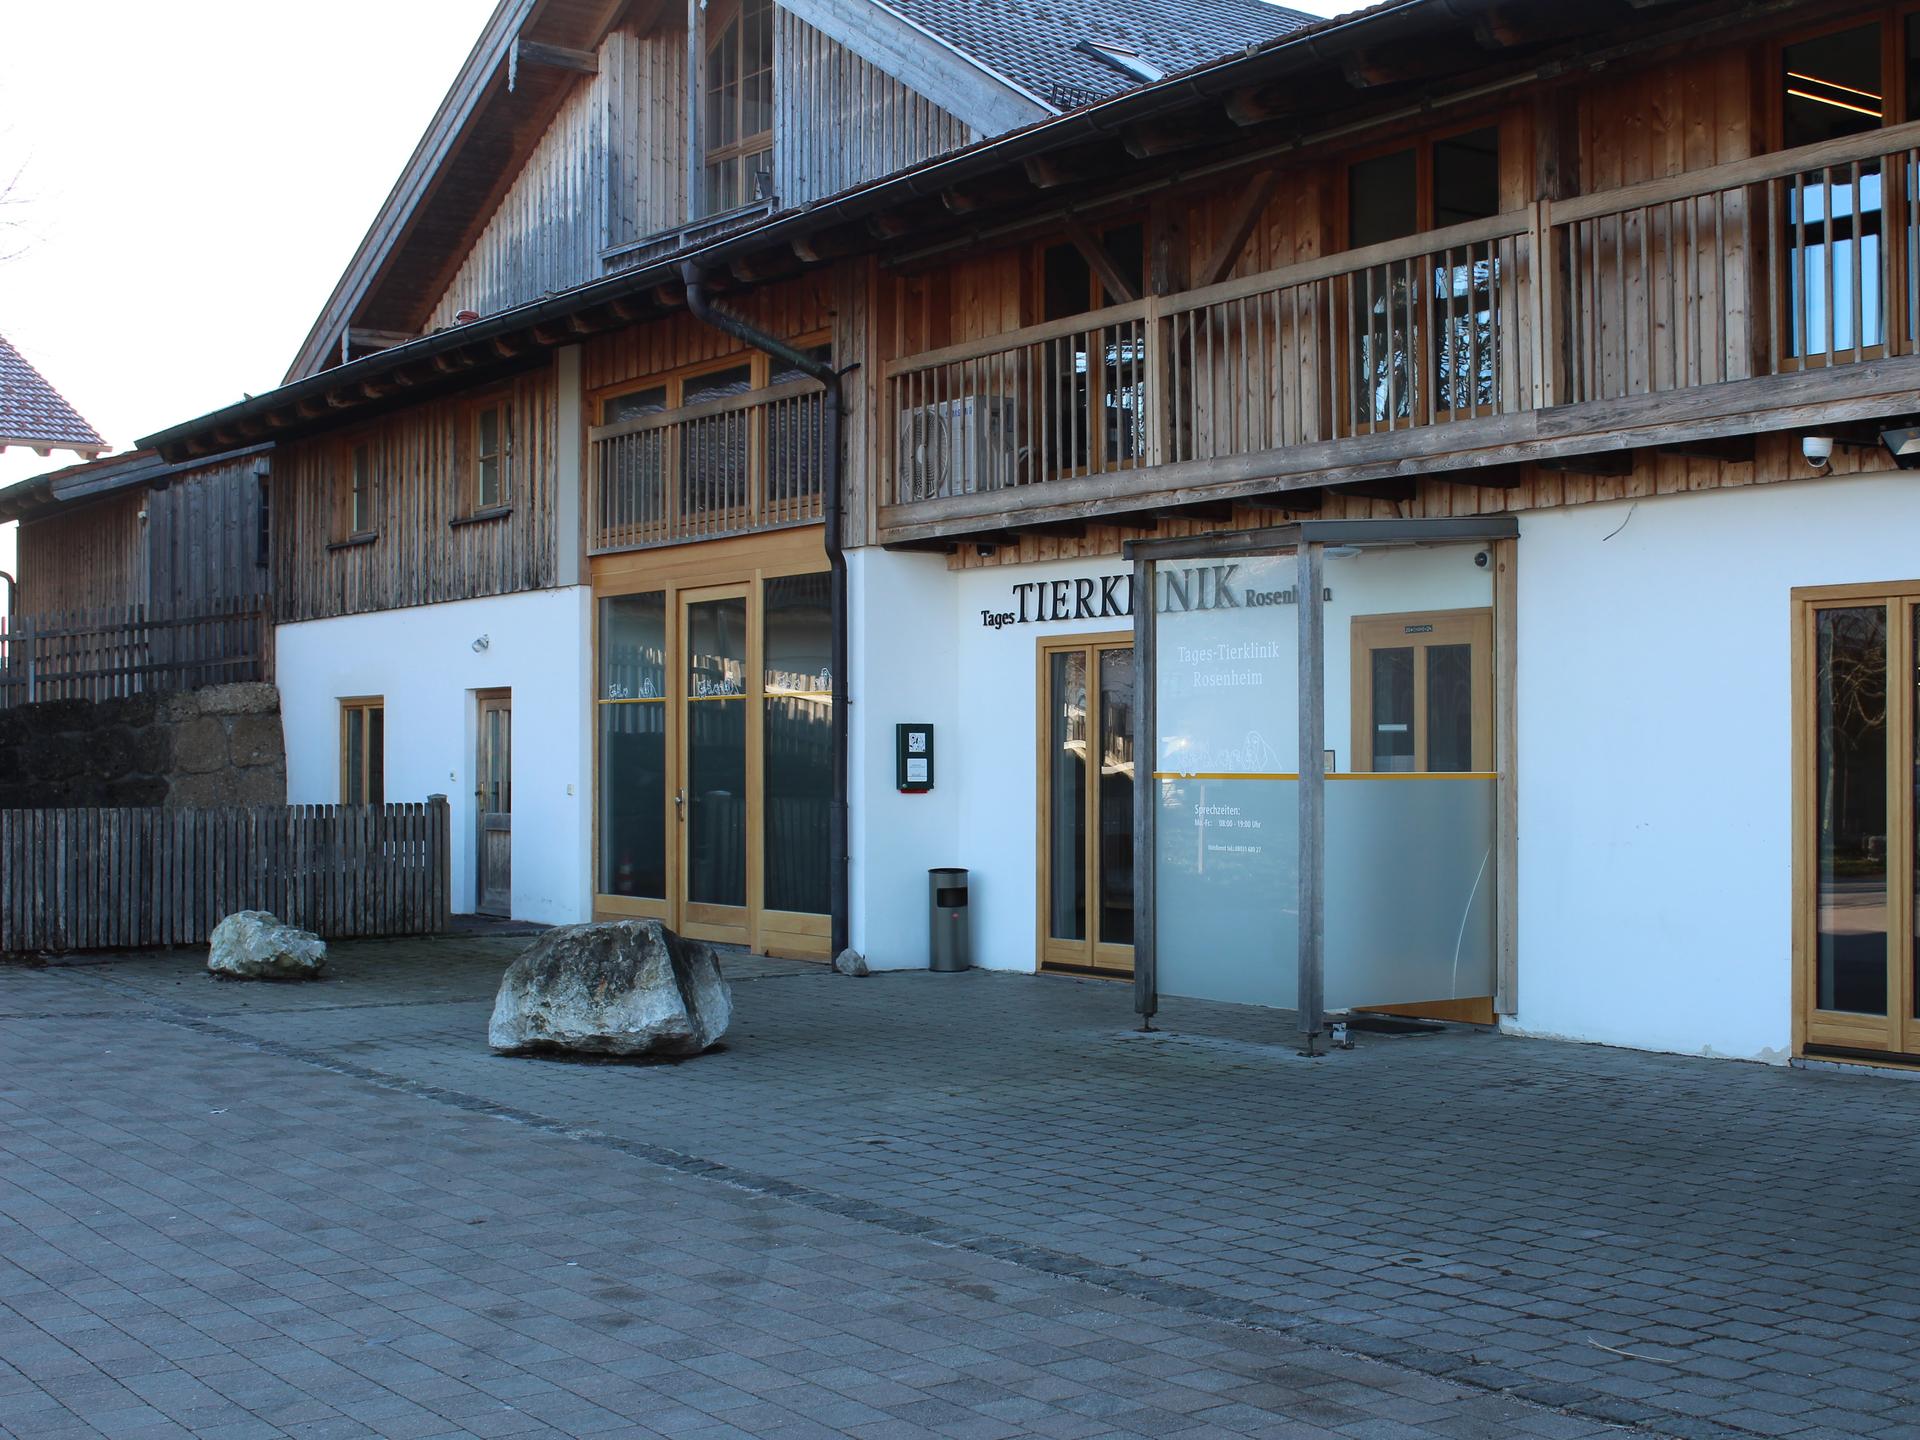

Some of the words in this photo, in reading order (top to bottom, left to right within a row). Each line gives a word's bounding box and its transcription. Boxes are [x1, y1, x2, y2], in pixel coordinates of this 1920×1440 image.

[980, 610, 1015, 630] Tages
[1012, 564, 1239, 623] TIERKNIK
[1245, 584, 1333, 608] Rosenhm
[1177, 641, 1280, 665] Tages-Tierklinik
[1193, 670, 1263, 687] Rosenheim
[1194, 804, 1241, 816] Sprechzeiten:
[1252, 820, 1262, 829] Uhr
